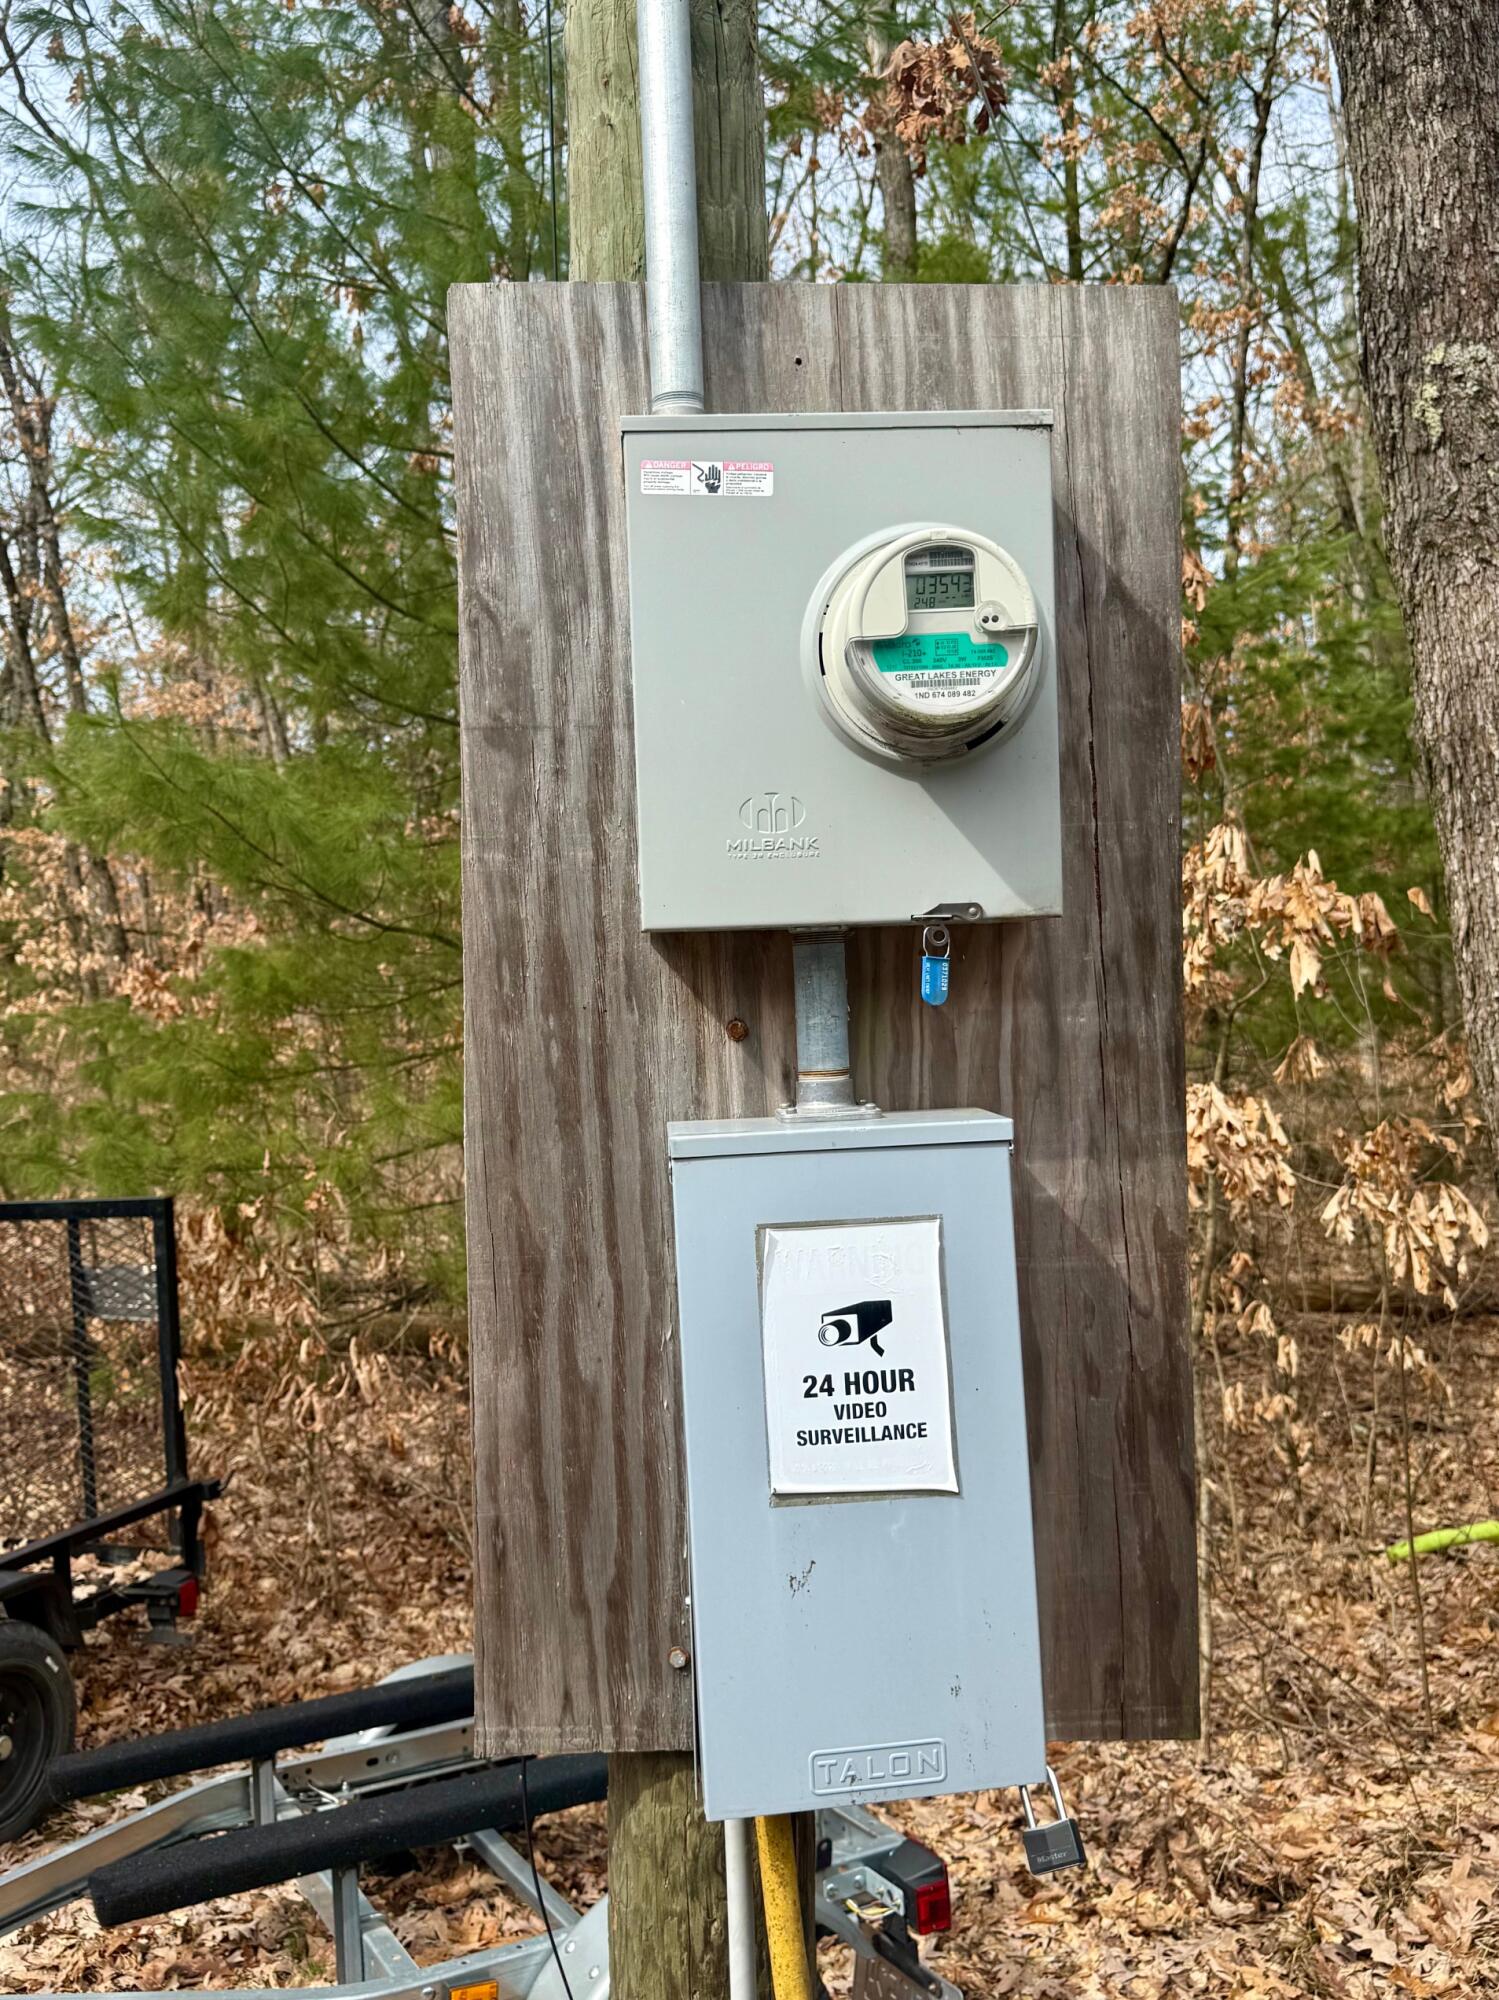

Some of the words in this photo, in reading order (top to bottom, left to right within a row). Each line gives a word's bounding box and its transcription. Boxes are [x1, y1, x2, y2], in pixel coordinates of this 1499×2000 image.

[653, 460, 686, 469] DANGER
[736, 462, 769, 471] PELIGRO
[916, 573, 972, 595] 03543
[914, 596, 936, 609] 248
[895, 672, 926, 682] GREAT
[928, 671, 957, 680] LAKES
[960, 669, 997, 679] ENERGY
[915, 691, 930, 699] 1ND
[948, 690, 961, 698] 089
[726, 837, 820, 852] MILBANK
[802, 1374, 835, 1399] 24
[844, 1368, 916, 1396] HOUR
[834, 1401, 887, 1420] VIDEO
[796, 1422, 928, 1446] SURVEILLANCE
[817, 1748, 940, 1785] TALON
